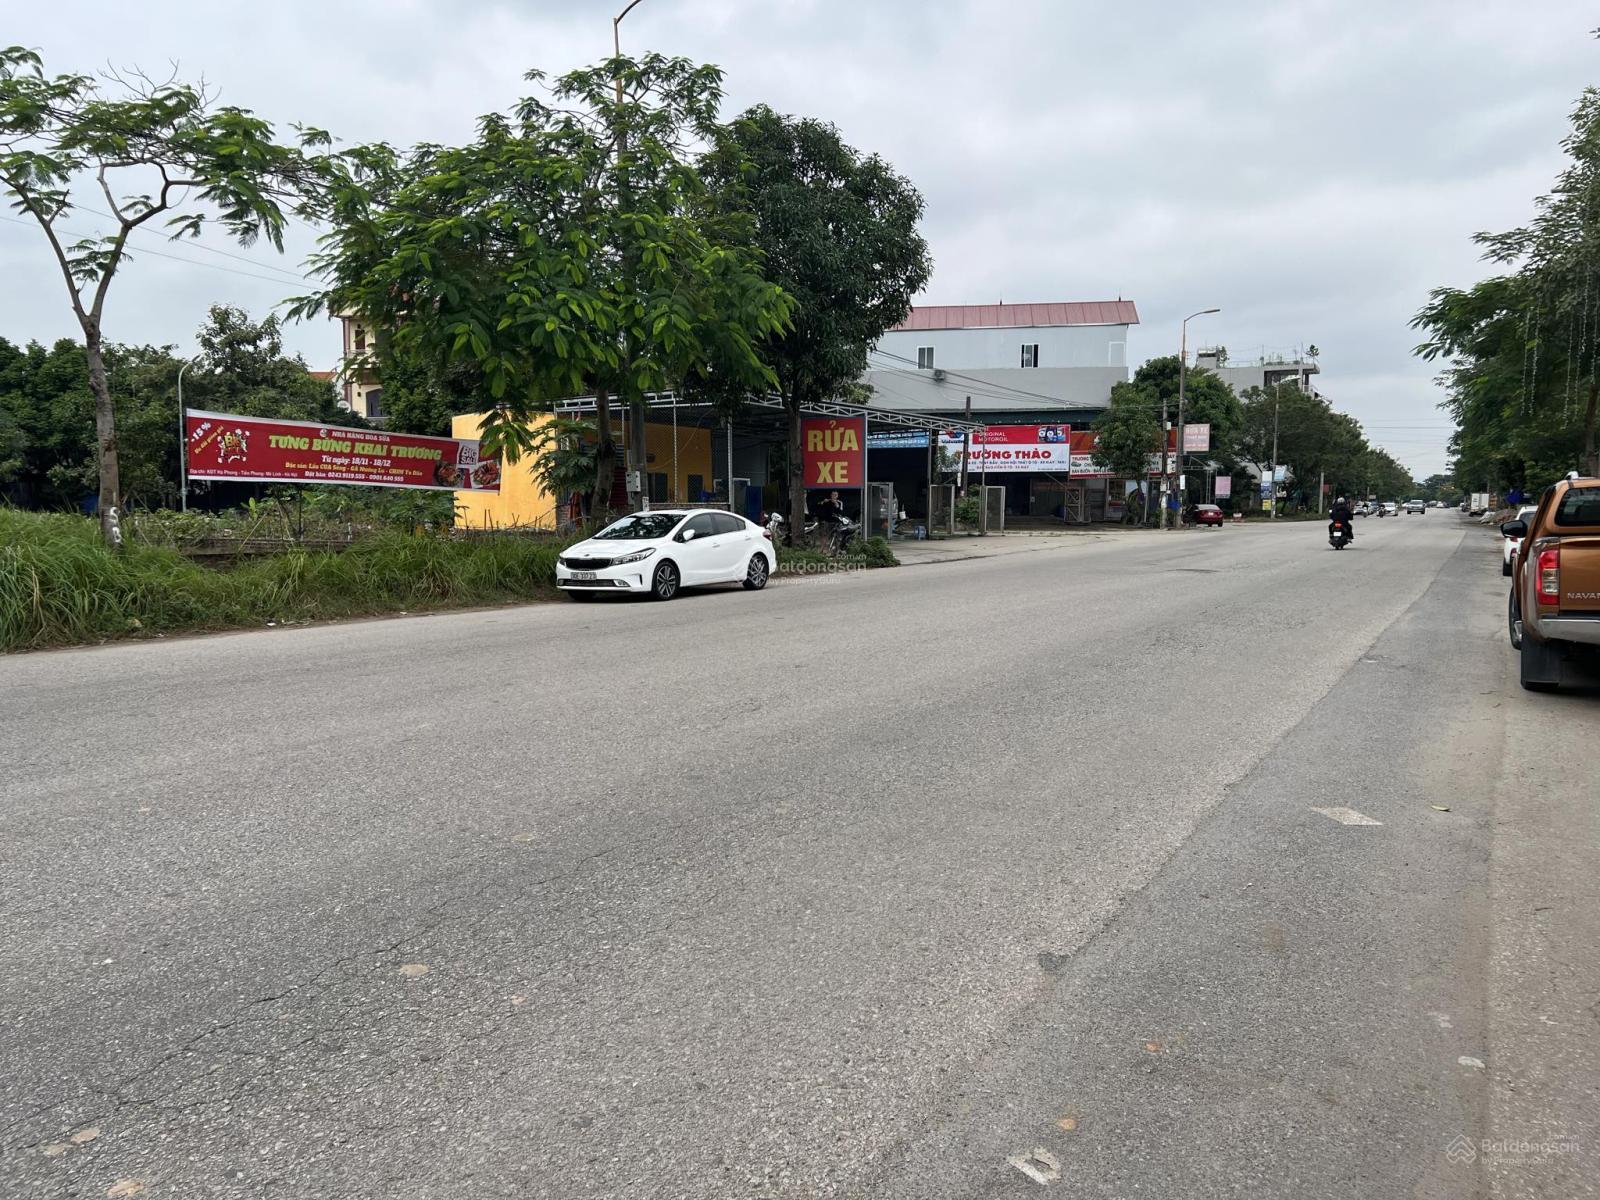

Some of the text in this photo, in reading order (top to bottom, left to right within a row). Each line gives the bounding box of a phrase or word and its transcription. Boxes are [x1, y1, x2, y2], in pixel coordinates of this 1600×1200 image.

[191, 422, 211, 442] -15%
[331, 430, 345, 438] NHÀ
[347, 430, 364, 440] HÀNG
[365, 433, 379, 441] HOA
[807, 419, 859, 452] RỬA
[312, 436, 351, 453] BỪNG
[354, 441, 388, 457] KHAI
[391, 445, 443, 460] TRƯƠNG
[461, 446, 477, 458] BIG
[1014, 447, 1052, 459] THẢO
[321, 455, 331, 463] Từ
[352, 456, 369, 466] 18/11
[373, 458, 392, 468] 18/12
[816, 461, 849, 484] XE
